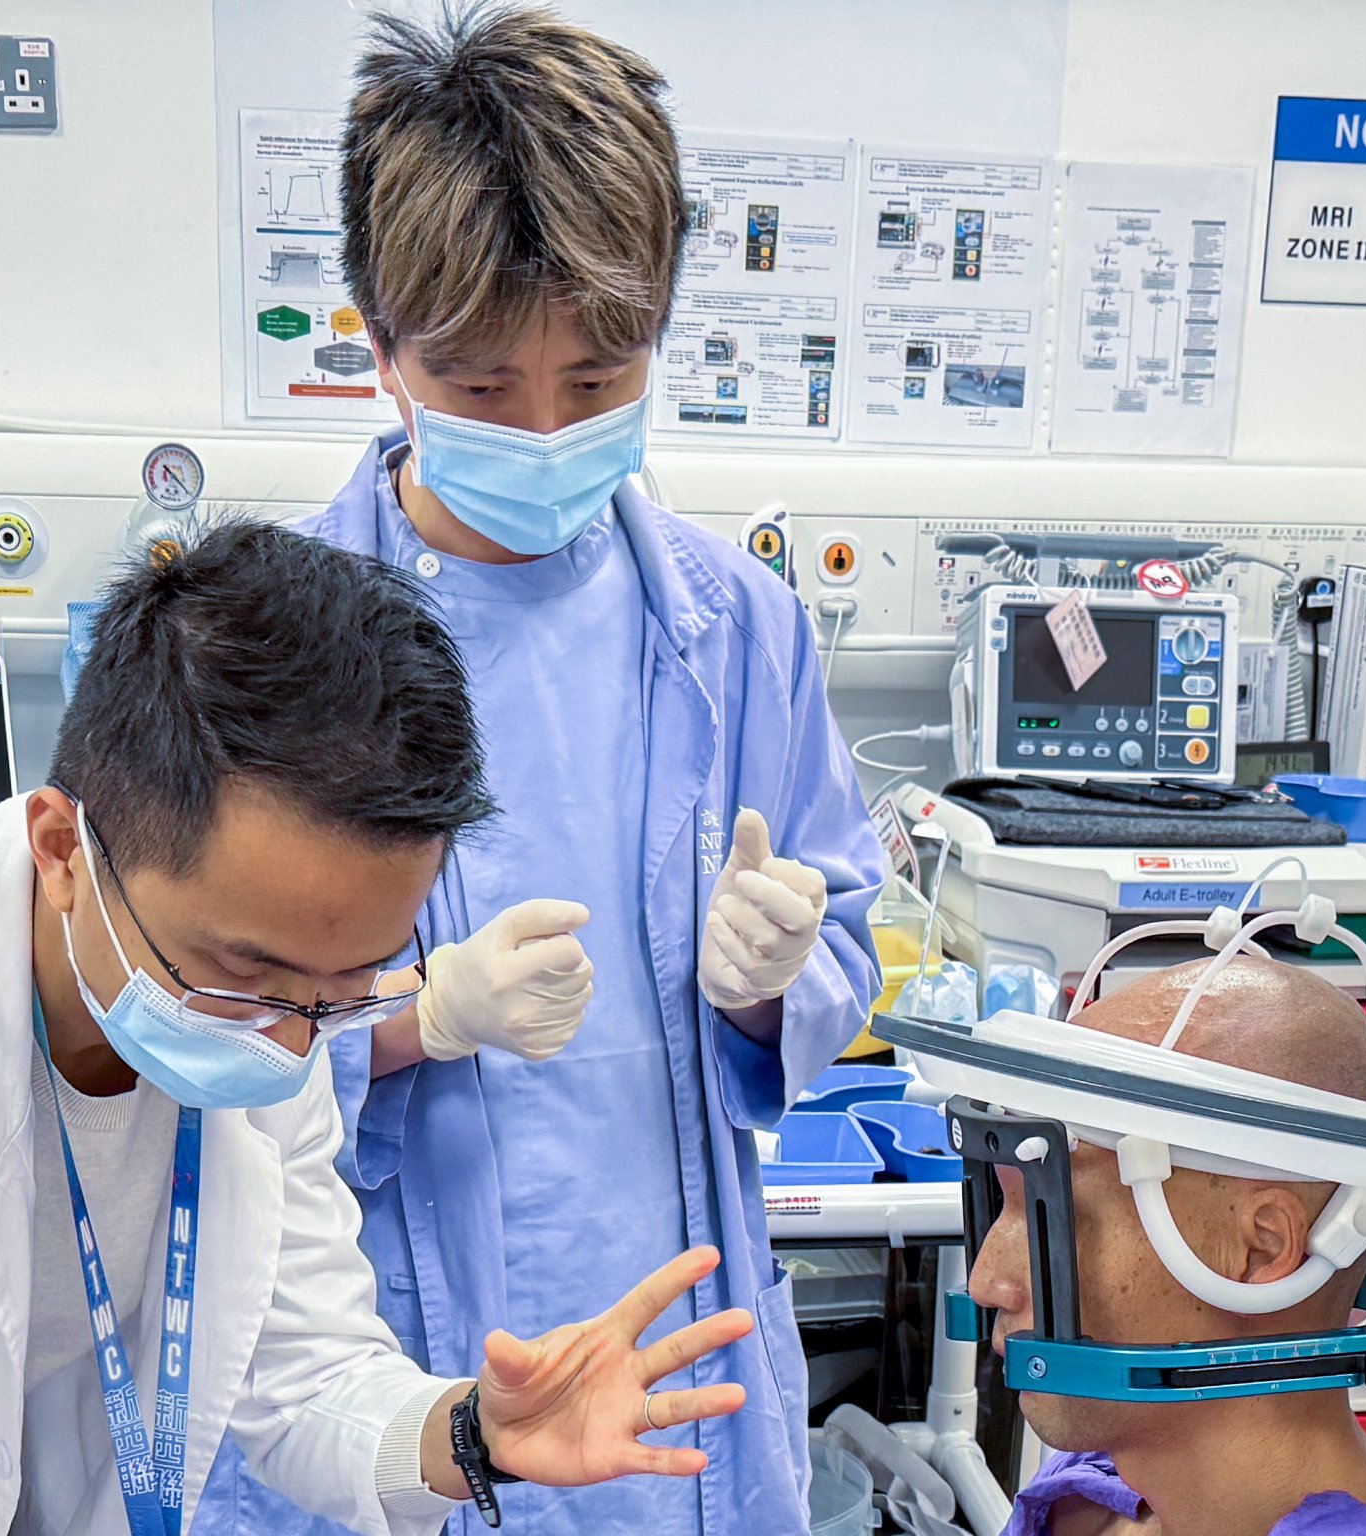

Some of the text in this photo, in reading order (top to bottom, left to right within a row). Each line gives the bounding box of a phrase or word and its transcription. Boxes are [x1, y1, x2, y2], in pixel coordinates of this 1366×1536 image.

[1310, 205, 1353, 228] MRI
[1286, 238, 1350, 260] ZONE
[1172, 858, 1231, 869] Flexline
[1142, 888, 1236, 903] Adult E-trolley
[165, 1206, 191, 1378] NTWC
